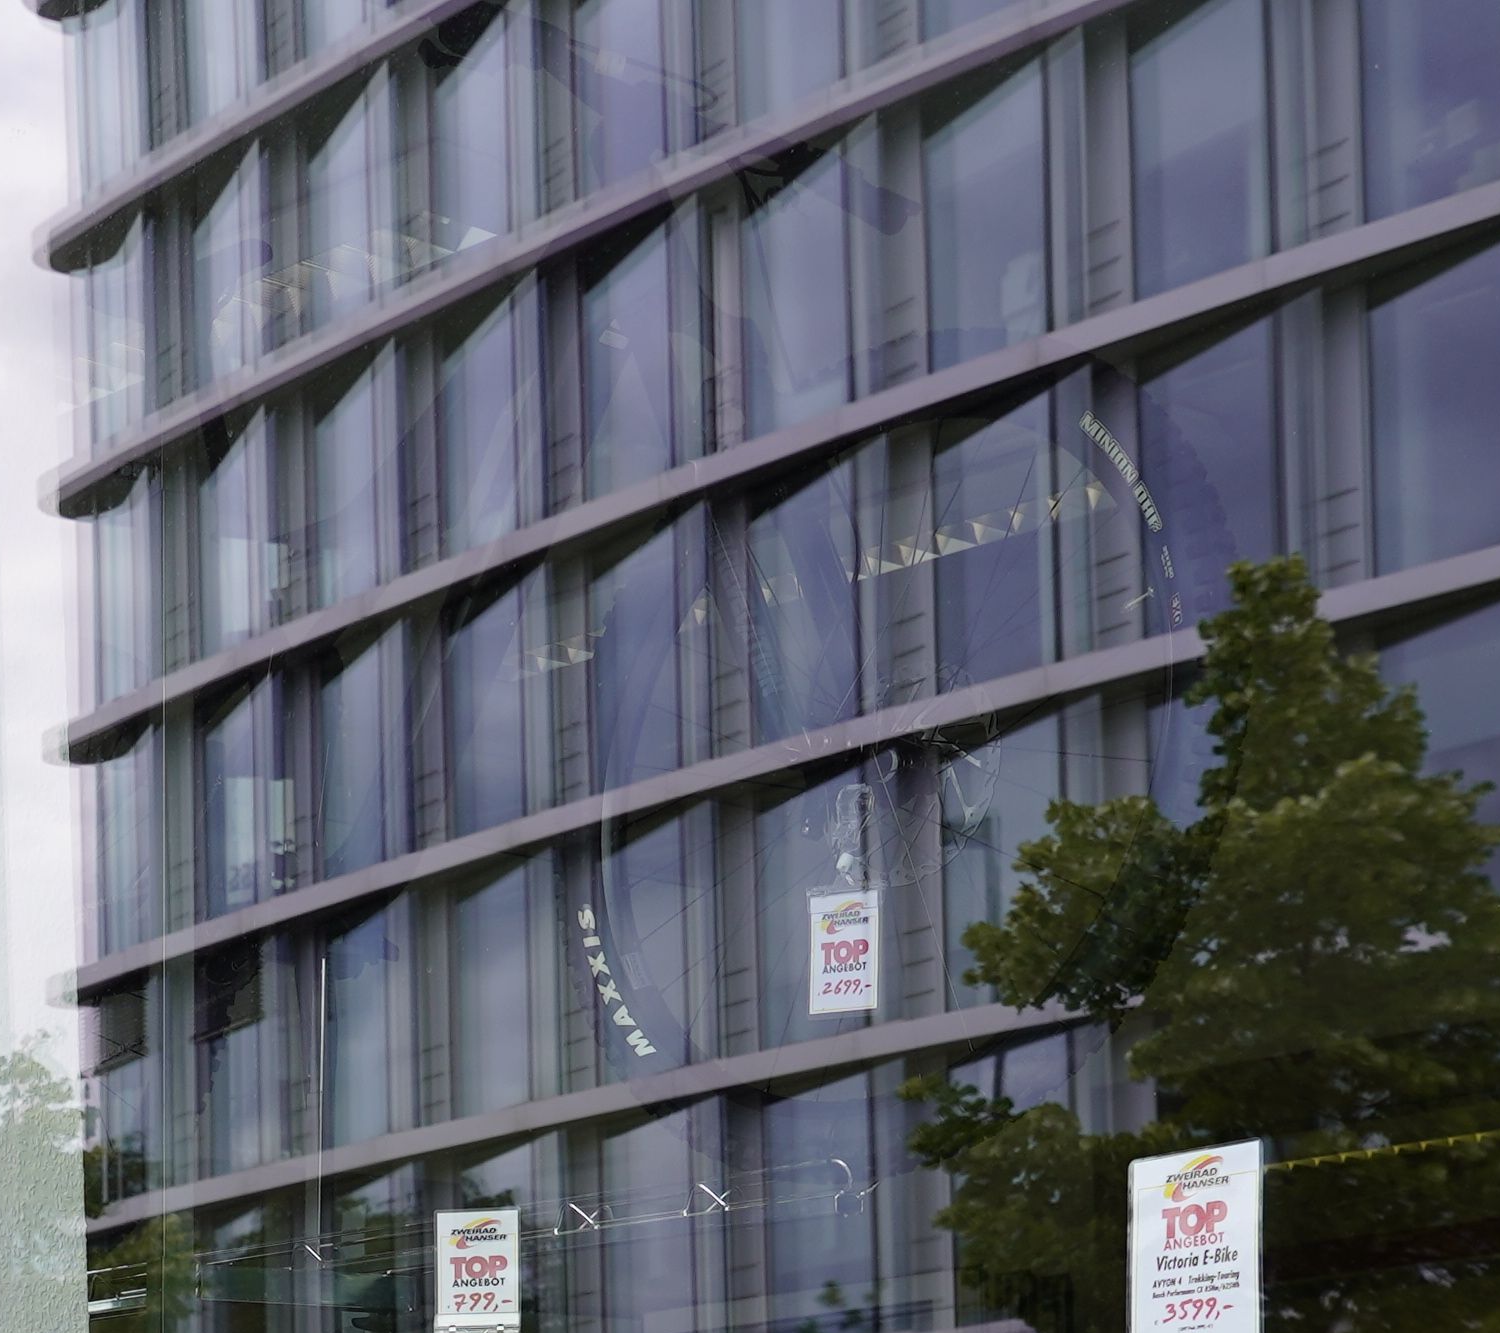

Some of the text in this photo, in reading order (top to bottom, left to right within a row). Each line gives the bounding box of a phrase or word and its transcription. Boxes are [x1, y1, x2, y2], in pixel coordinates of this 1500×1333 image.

[821, 939, 869, 964] TOP
[823, 962, 866, 974] ANGEBOT
[577, 908, 657, 1058] MAXXIS
[1162, 1201, 1227, 1239] TOP
[1164, 1232, 1224, 1251] ANGEBOT
[450, 1255, 507, 1279] TOP
[1157, 1246, 1238, 1271] Victoria E-Bike
[452, 1277, 505, 1287] ANGEBOT
